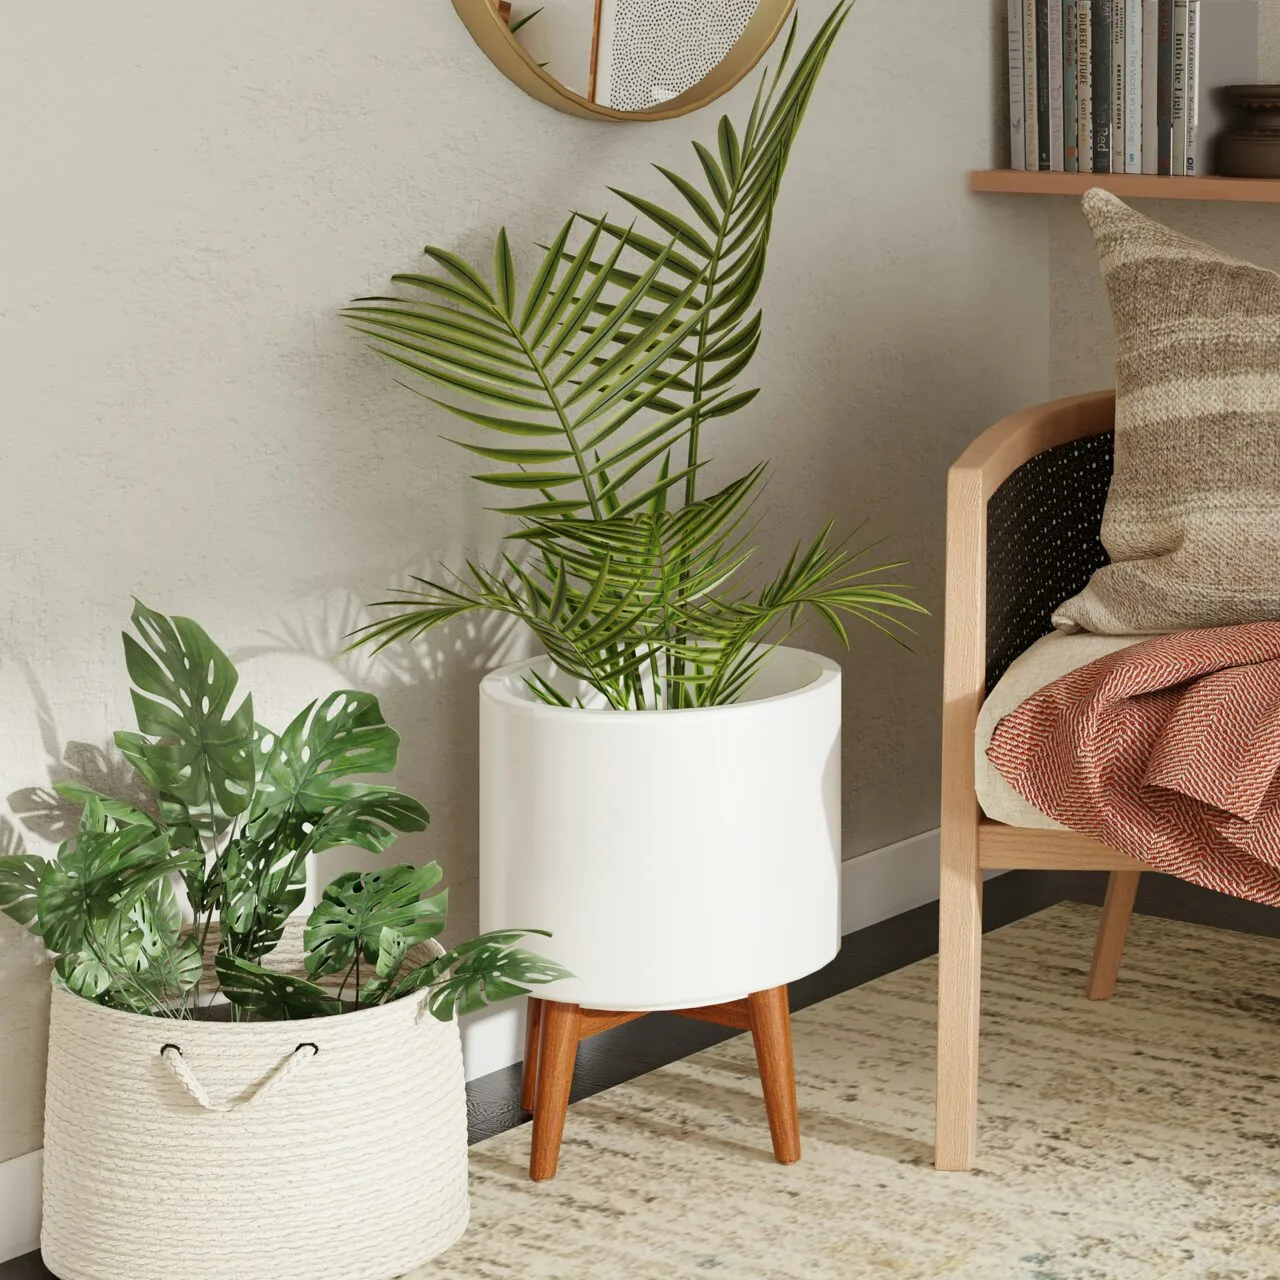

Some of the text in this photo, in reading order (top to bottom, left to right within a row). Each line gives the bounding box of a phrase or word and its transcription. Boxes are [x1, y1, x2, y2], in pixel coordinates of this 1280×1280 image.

[1079, 13, 1088, 86] DILBERT FUTURE
[1173, 32, 1184, 119] Into the Light
[1188, 32, 1196, 81] NOTEBOOK
[1097, 127, 1109, 152] Red
